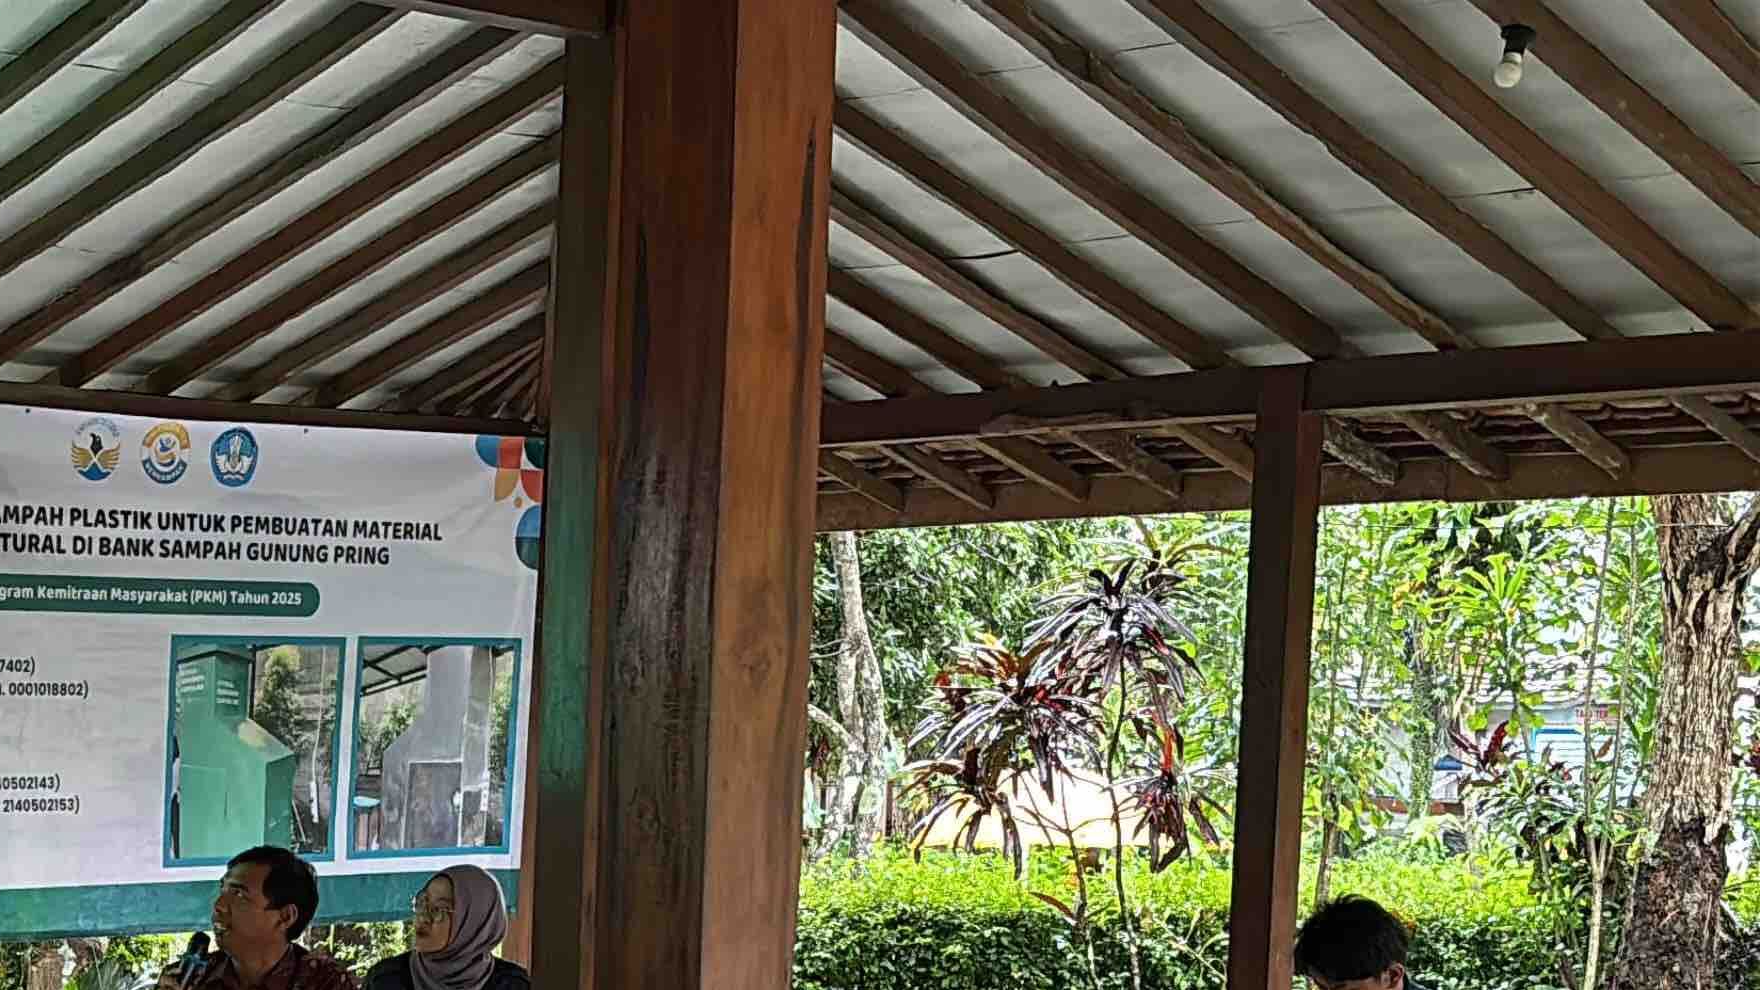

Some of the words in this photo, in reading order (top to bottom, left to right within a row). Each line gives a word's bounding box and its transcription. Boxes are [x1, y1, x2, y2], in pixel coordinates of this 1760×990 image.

[69, 507, 152, 531] PLASTIK
[157, 511, 226, 534] UNTUK
[230, 514, 348, 538] PEMBUATAN
[353, 519, 443, 542] MATERIAL
[72, 535, 92, 555] DI
[98, 536, 155, 558] BANK
[159, 538, 241, 561] SAMPAH
[246, 541, 329, 564] GUNUNG
[333, 545, 390, 566] PRING
[37, 584, 108, 602] Kemitraan
[111, 586, 188, 606] Masyarakat
[190, 587, 228, 606] (PKM)
[230, 589, 268, 605] Tahun
[271, 590, 302, 606] 2025
[8, 680, 89, 700] 0001018802)
[2, 795, 81, 815] 2140502153)
